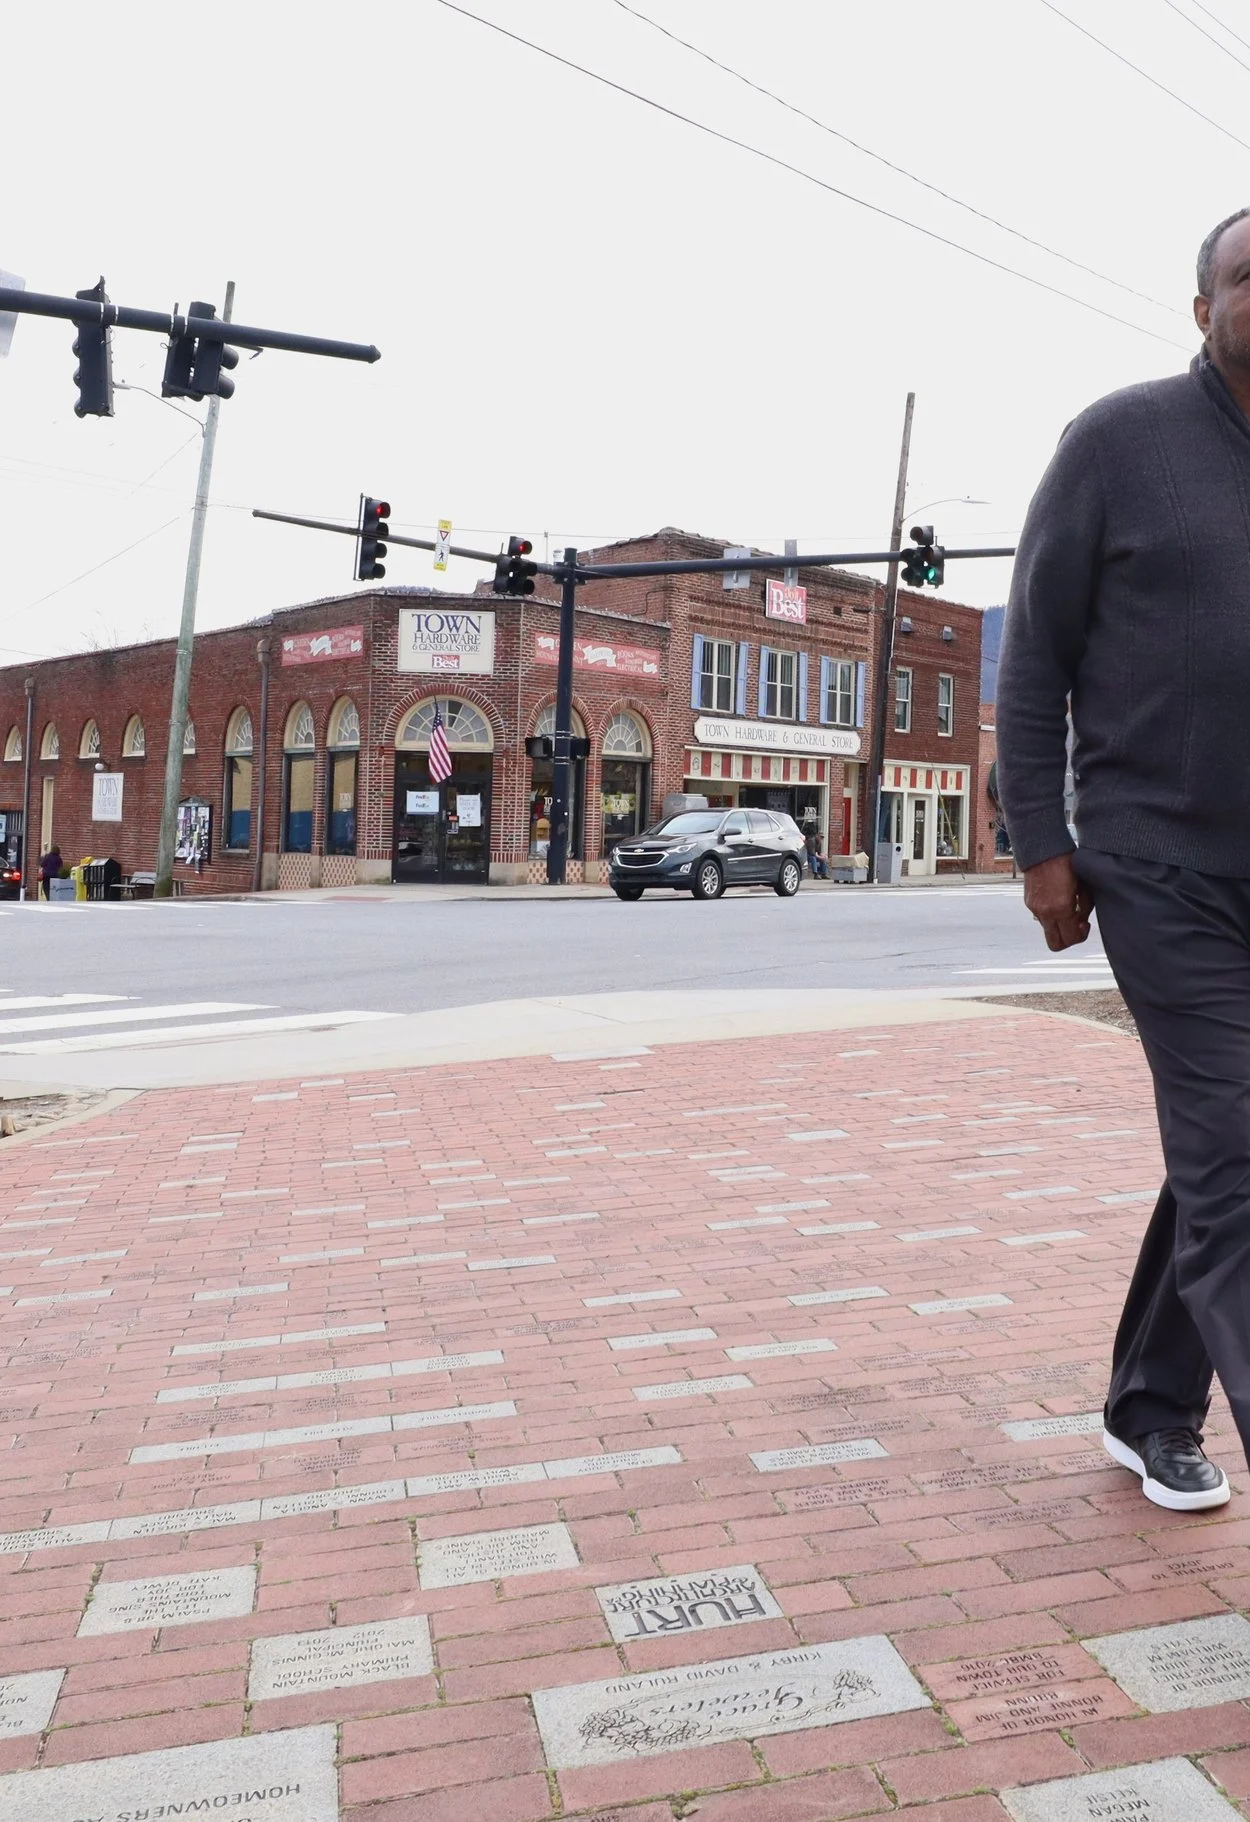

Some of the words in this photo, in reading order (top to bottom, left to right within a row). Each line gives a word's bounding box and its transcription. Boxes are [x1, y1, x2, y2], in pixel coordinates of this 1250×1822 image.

[772, 588, 804, 619] Best
[412, 613, 482, 634] TOWN
[413, 633, 481, 645] HARDWARE
[412, 643, 419, 651] &
[418, 644, 452, 653] GENERAL
[455, 644, 480, 653] STORE
[433, 656, 460, 669] Best
[704, 724, 729, 738] TOWN
[735, 726, 778, 743] HARDWARE
[793, 733, 826, 748] GENERAL
[831, 738, 853, 749] STORE
[179, 1584, 205, 1592] FOR
[136, 1590, 205, 1602] TOGETHER
[149, 1593, 231, 1608] MOUNTAINS
[607, 1582, 756, 1614] ARCHITECTURE
[107, 1604, 141, 1614] SING
[624, 1593, 767, 1638] HURT
[306, 1638, 379, 1653] PRINCIPAL
[1166, 1642, 1228, 1660] WILLIAM
[340, 1655, 409, 1670] PRIMARY
[769, 1651, 821, 1667] KIRBY
[1041, 1659, 1060, 1669] TO
[277, 1666, 333, 1680] SCHOOL
[361, 1662, 410, 1674] BLACK
[686, 1665, 740, 1681] DAVID
[1006, 1663, 1037, 1674] OUR
[1036, 1669, 1066, 1681] FOR
[1152, 1666, 1217, 1684] DISTRICT
[272, 1671, 354, 1689] MOUNTAIN
[955, 1669, 1002, 1683] TOWN
[1191, 1673, 1240, 1690] HONOR
[603, 1675, 679, 1694] RULAND
[971, 1676, 1031, 1692] SERVICE
[1171, 1684, 1187, 1694] OF
[648, 1682, 796, 1717] Jewelers
[1050, 1694, 1104, 1710] BONNIE
[708, 1694, 804, 1721] Grace
[1009, 1705, 1040, 1718] AND
[1081, 1707, 1099, 1716] IN
[975, 1712, 1002, 1724] JIM
[999, 1720, 1019, 1731] OF
[1023, 1711, 1078, 1727] HONOR
[116, 1783, 301, 1821] HOMEOWNERS
[1087, 1798, 1151, 1818] MEGAN
